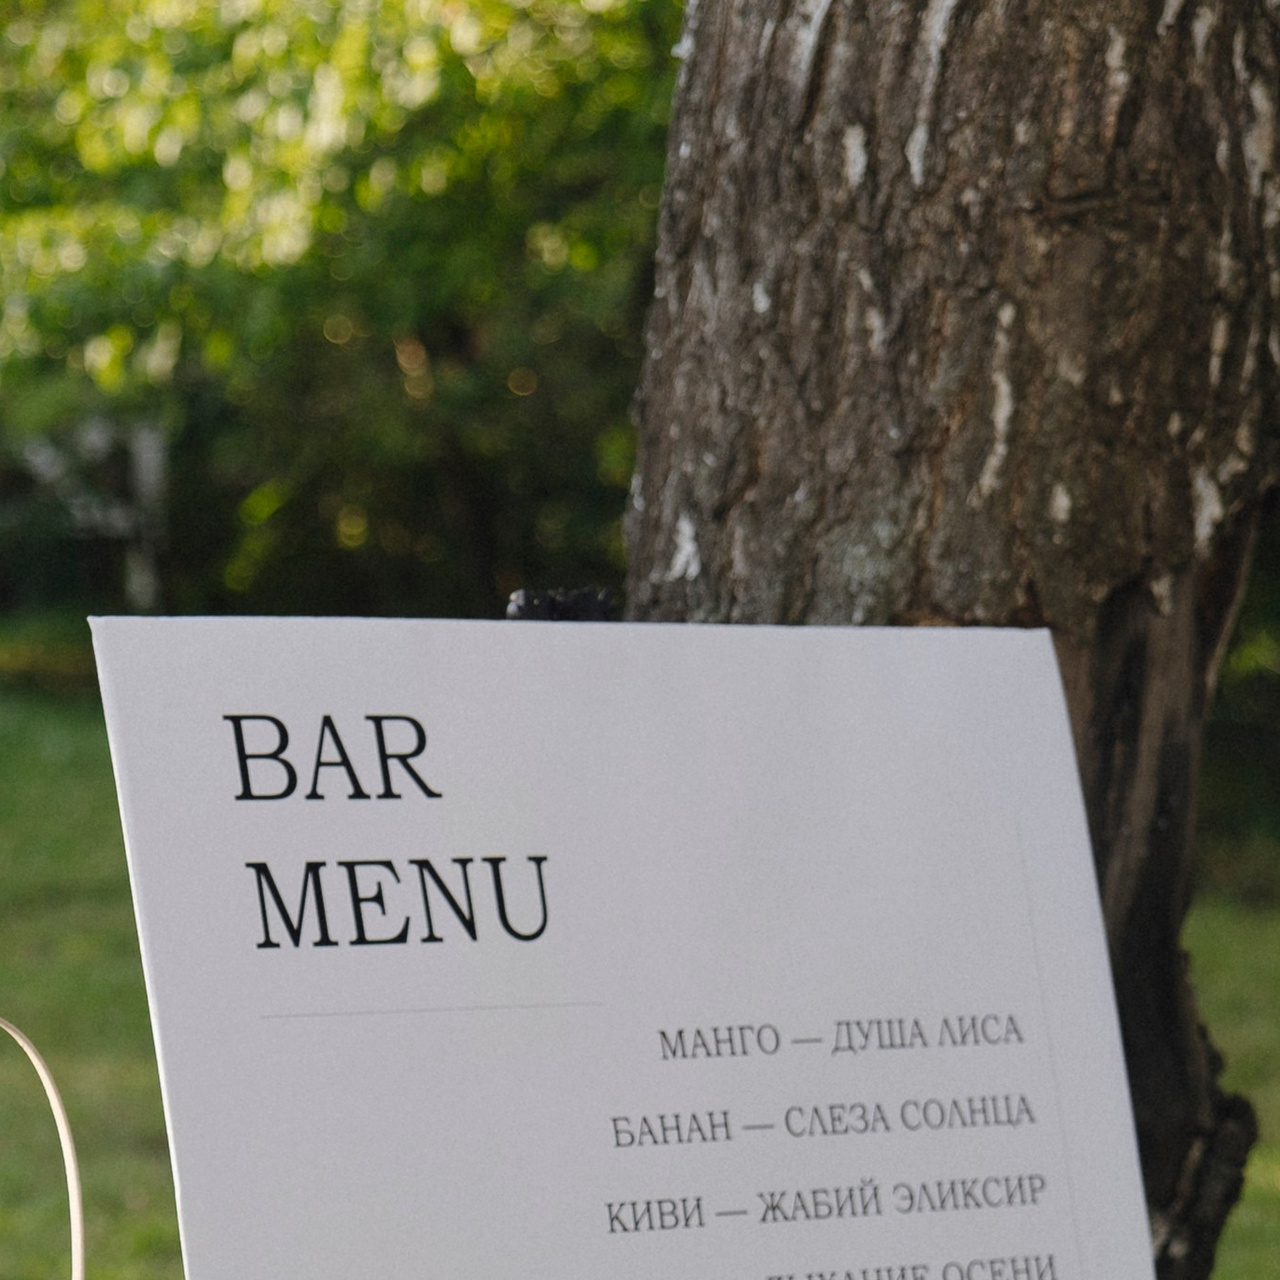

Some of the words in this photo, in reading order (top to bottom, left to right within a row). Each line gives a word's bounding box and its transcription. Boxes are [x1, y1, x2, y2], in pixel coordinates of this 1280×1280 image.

[222, 714, 443, 801] BAR
[245, 855, 548, 949] MENU
[658, 1024, 780, 1060] МАНГО
[831, 1018, 929, 1055] ДУША
[938, 1014, 1024, 1047] ЛИСА
[611, 1110, 732, 1148] БАНАН
[784, 1103, 891, 1138] СЛЕЗА
[900, 1094, 1036, 1131] СОЛНЦА
[606, 1196, 705, 1234] КИВИ
[757, 1178, 882, 1224] ЖАБИЙ
[892, 1174, 1046, 1214] ЭЛИКСИР
